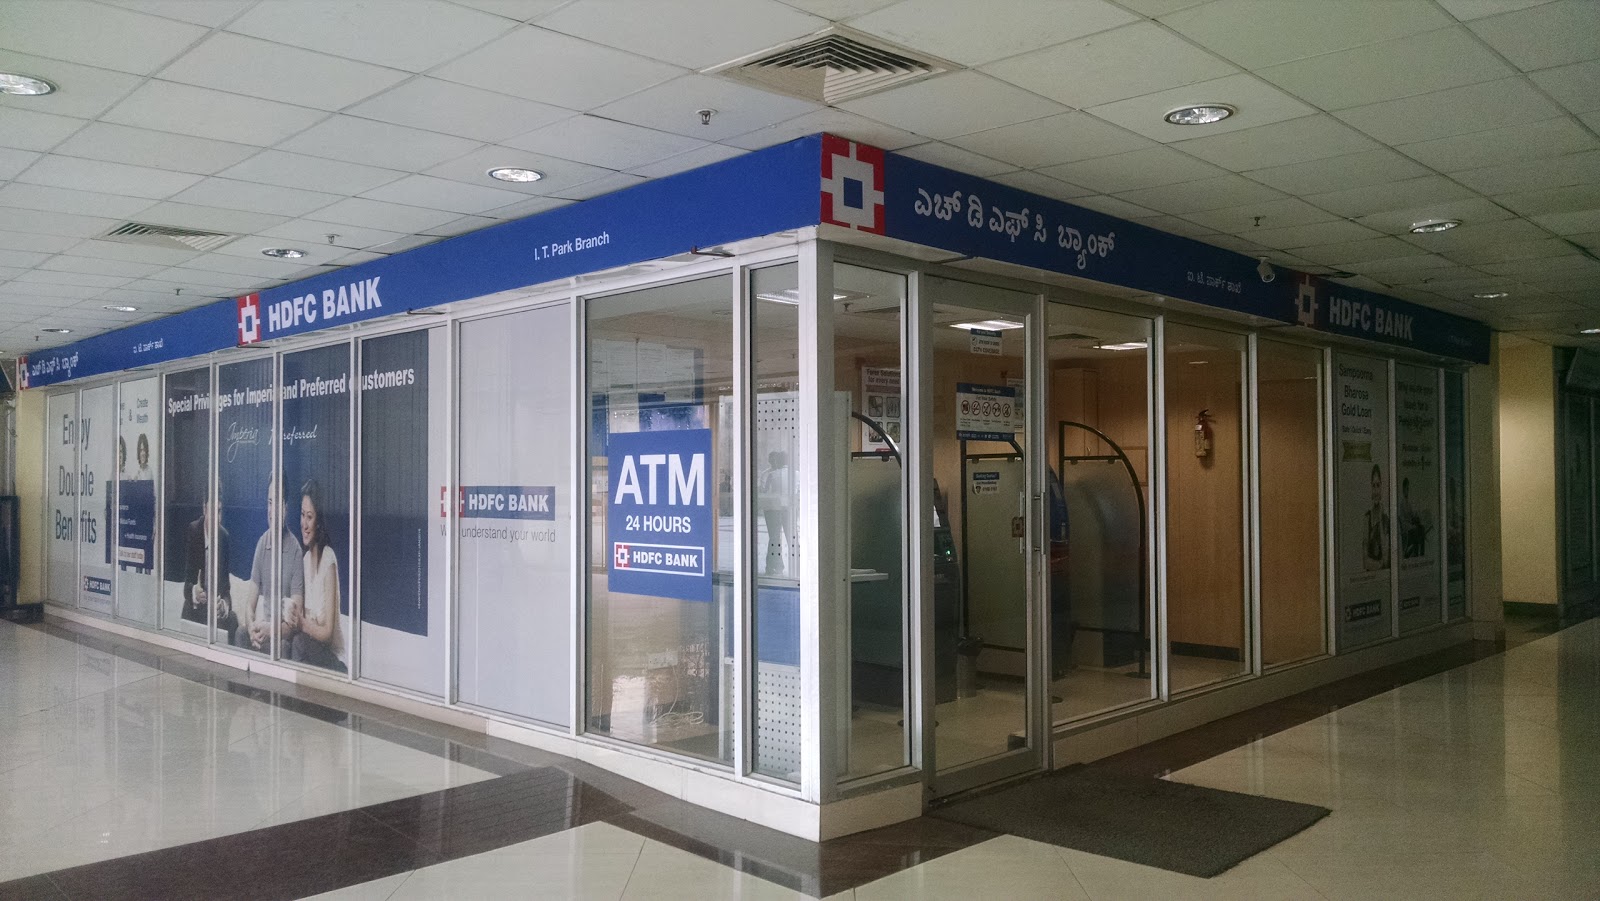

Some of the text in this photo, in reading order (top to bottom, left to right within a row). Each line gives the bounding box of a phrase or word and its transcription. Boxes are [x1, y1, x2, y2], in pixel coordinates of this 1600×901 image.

[542, 245, 549, 259] T.
[551, 241, 573, 257] Park
[575, 231, 610, 254] Branch
[967, 194, 984, 229] ಡಿ
[1034, 214, 1047, 242] ಸಿ
[1058, 225, 1115, 269] ಬ್ಯಾಂಕ್
[268, 276, 382, 332] HDFC BANK
[1329, 296, 1414, 341] HDFC BANK
[168, 391, 193, 416] Special
[194, 391, 232, 412] Priviges
[233, 389, 244, 406] for
[246, 383, 274, 408] Imperi
[300, 373, 346, 398] Preferred
[348, 368, 415, 391] ustomers
[1344, 385, 1369, 400] Bharosa
[1341, 403, 1372, 419] Gold Loan
[63, 414, 91, 451] Enoy
[614, 453, 705, 506] ATM
[468, 493, 549, 512] HDFC BANK
[55, 508, 97, 543] Benfits
[461, 525, 508, 540] understand
[510, 529, 529, 543] your
[531, 528, 556, 543] world
[625, 515, 692, 533] 24 HOURS
[633, 550, 698, 568] HDFC BANK
